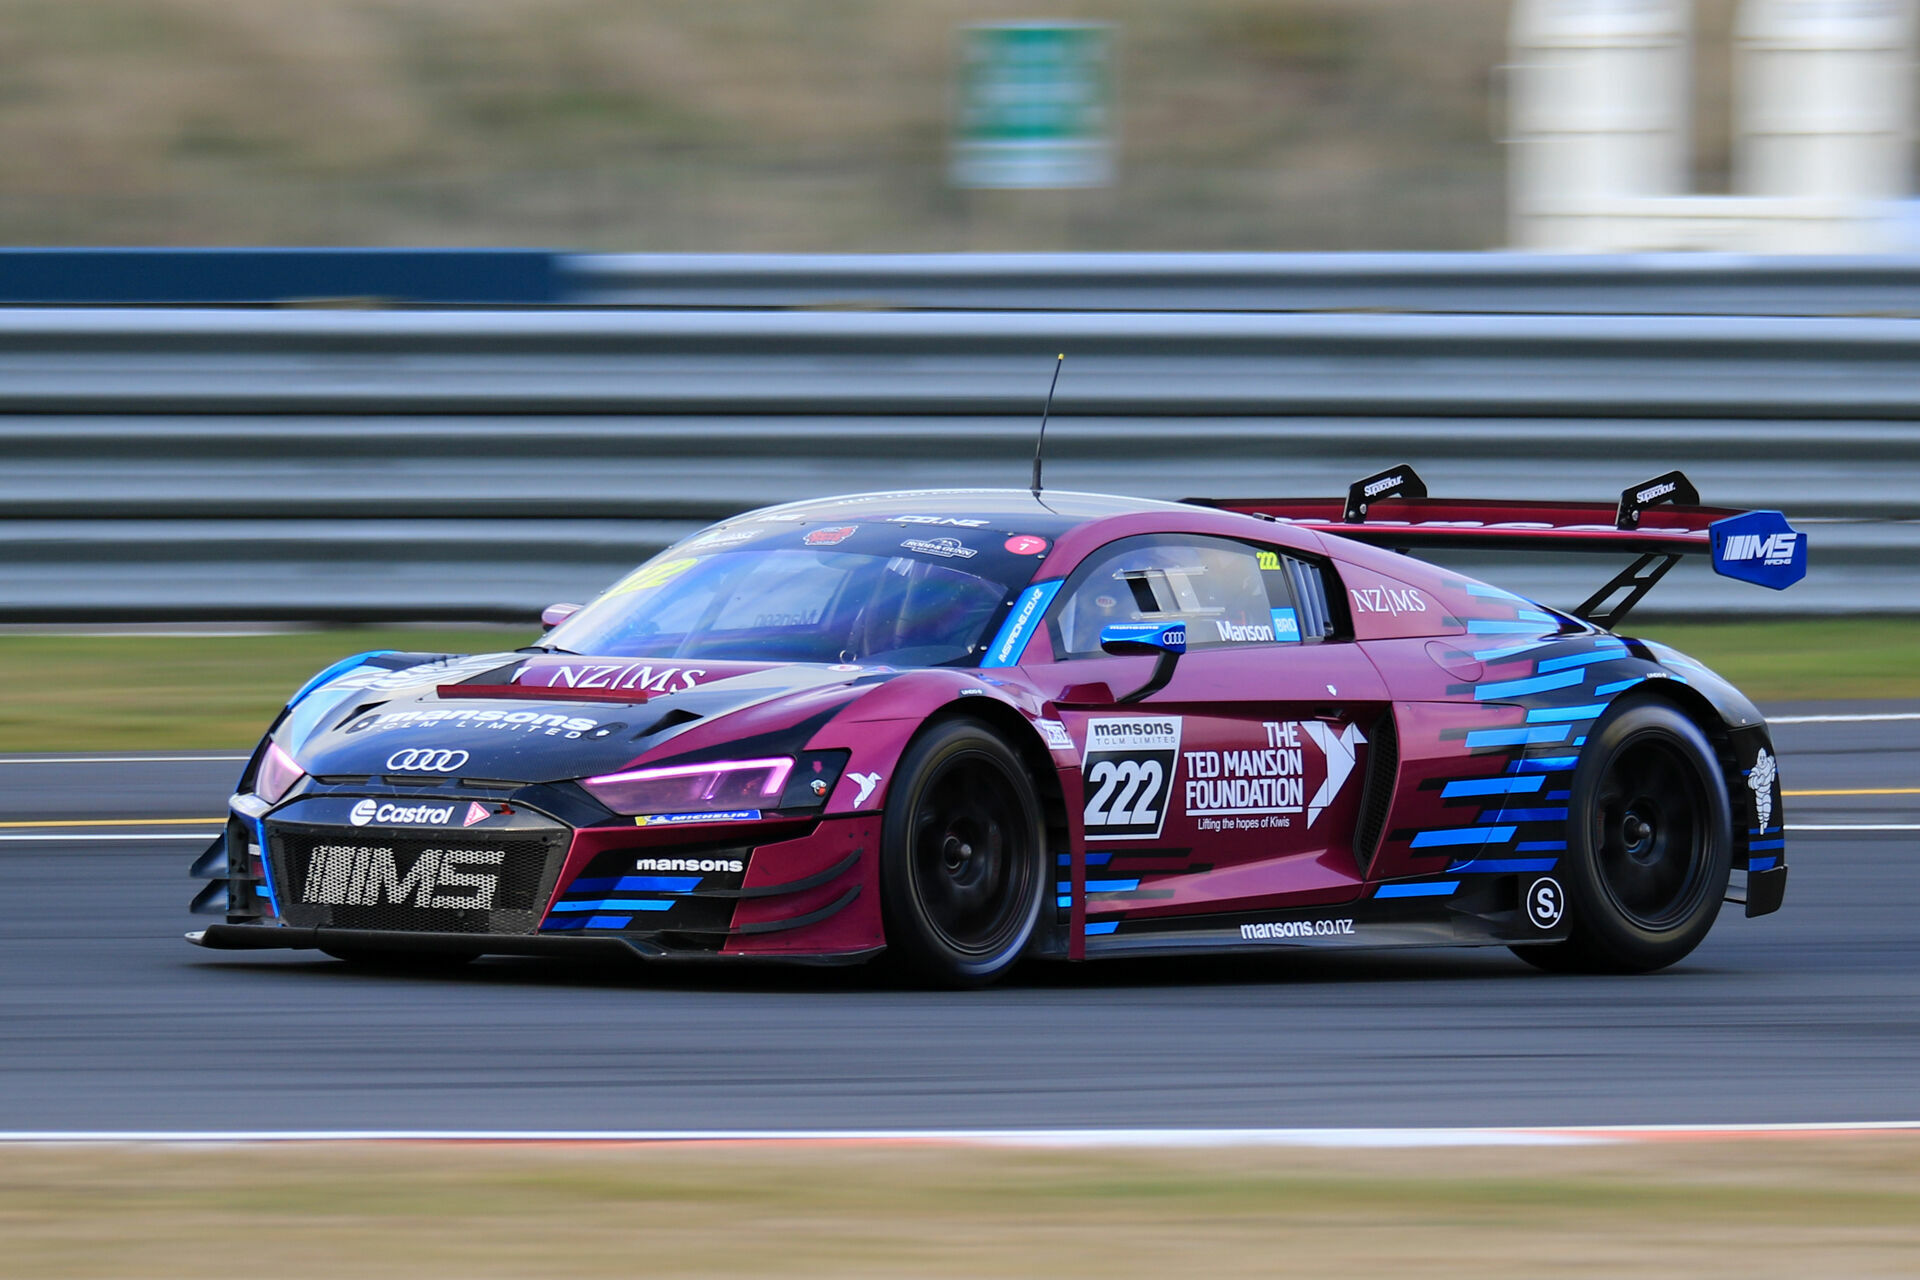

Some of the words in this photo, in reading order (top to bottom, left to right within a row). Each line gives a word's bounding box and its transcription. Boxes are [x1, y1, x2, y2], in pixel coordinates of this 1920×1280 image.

[1257, 552, 1280, 570] 222
[1216, 621, 1275, 642] Manson
[376, 709, 598, 732] mansons
[455, 719, 582, 739] LIMITED
[1095, 722, 1174, 737] mansons
[1096, 737, 1126, 745] TCLM
[1133, 736, 1176, 744] LIMITED
[1262, 721, 1302, 748] THE
[1184, 751, 1219, 778] TED
[1223, 748, 1303, 777] MANSON
[1083, 760, 1163, 825] 222
[1185, 777, 1303, 809] FOUNDATION
[375, 803, 455, 824] Castrol
[671, 812, 750, 822] MICHELIN
[1198, 818, 1221, 832] Lifting
[1223, 817, 1235, 829] the
[1236, 817, 1259, 831] hopes
[1261, 816, 1270, 828] of
[1269, 816, 1290, 828] Kiwis
[636, 858, 743, 873] mansons
[1240, 918, 1355, 940] mansons.co.nz
